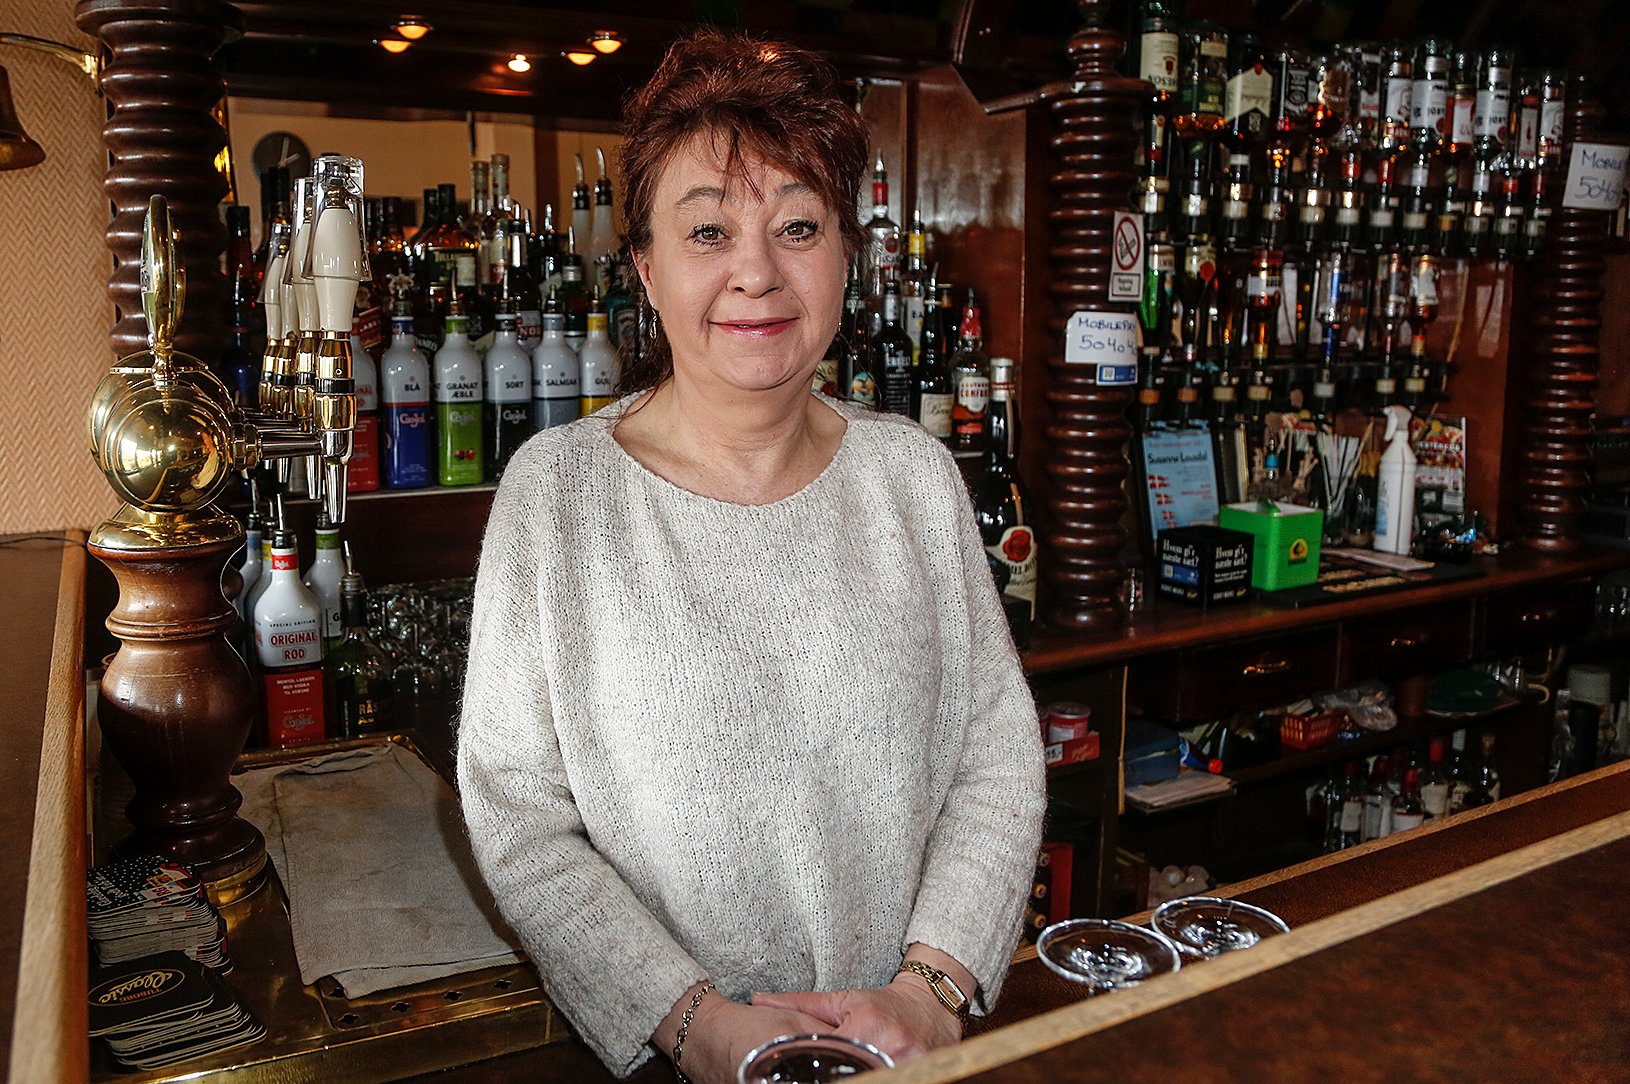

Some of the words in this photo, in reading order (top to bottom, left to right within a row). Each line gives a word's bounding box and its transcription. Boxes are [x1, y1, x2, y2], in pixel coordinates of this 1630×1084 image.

[405, 381, 421, 391] BLÅ
[446, 382, 479, 390] GRANAT
[506, 381, 525, 389] SORT
[452, 390, 473, 398] ÆBLE
[271, 632, 316, 646] ORIGINAL
[285, 648, 305, 660] RØD
[98, 971, 173, 1004] Classic
[119, 986, 163, 1003] TUBORG
